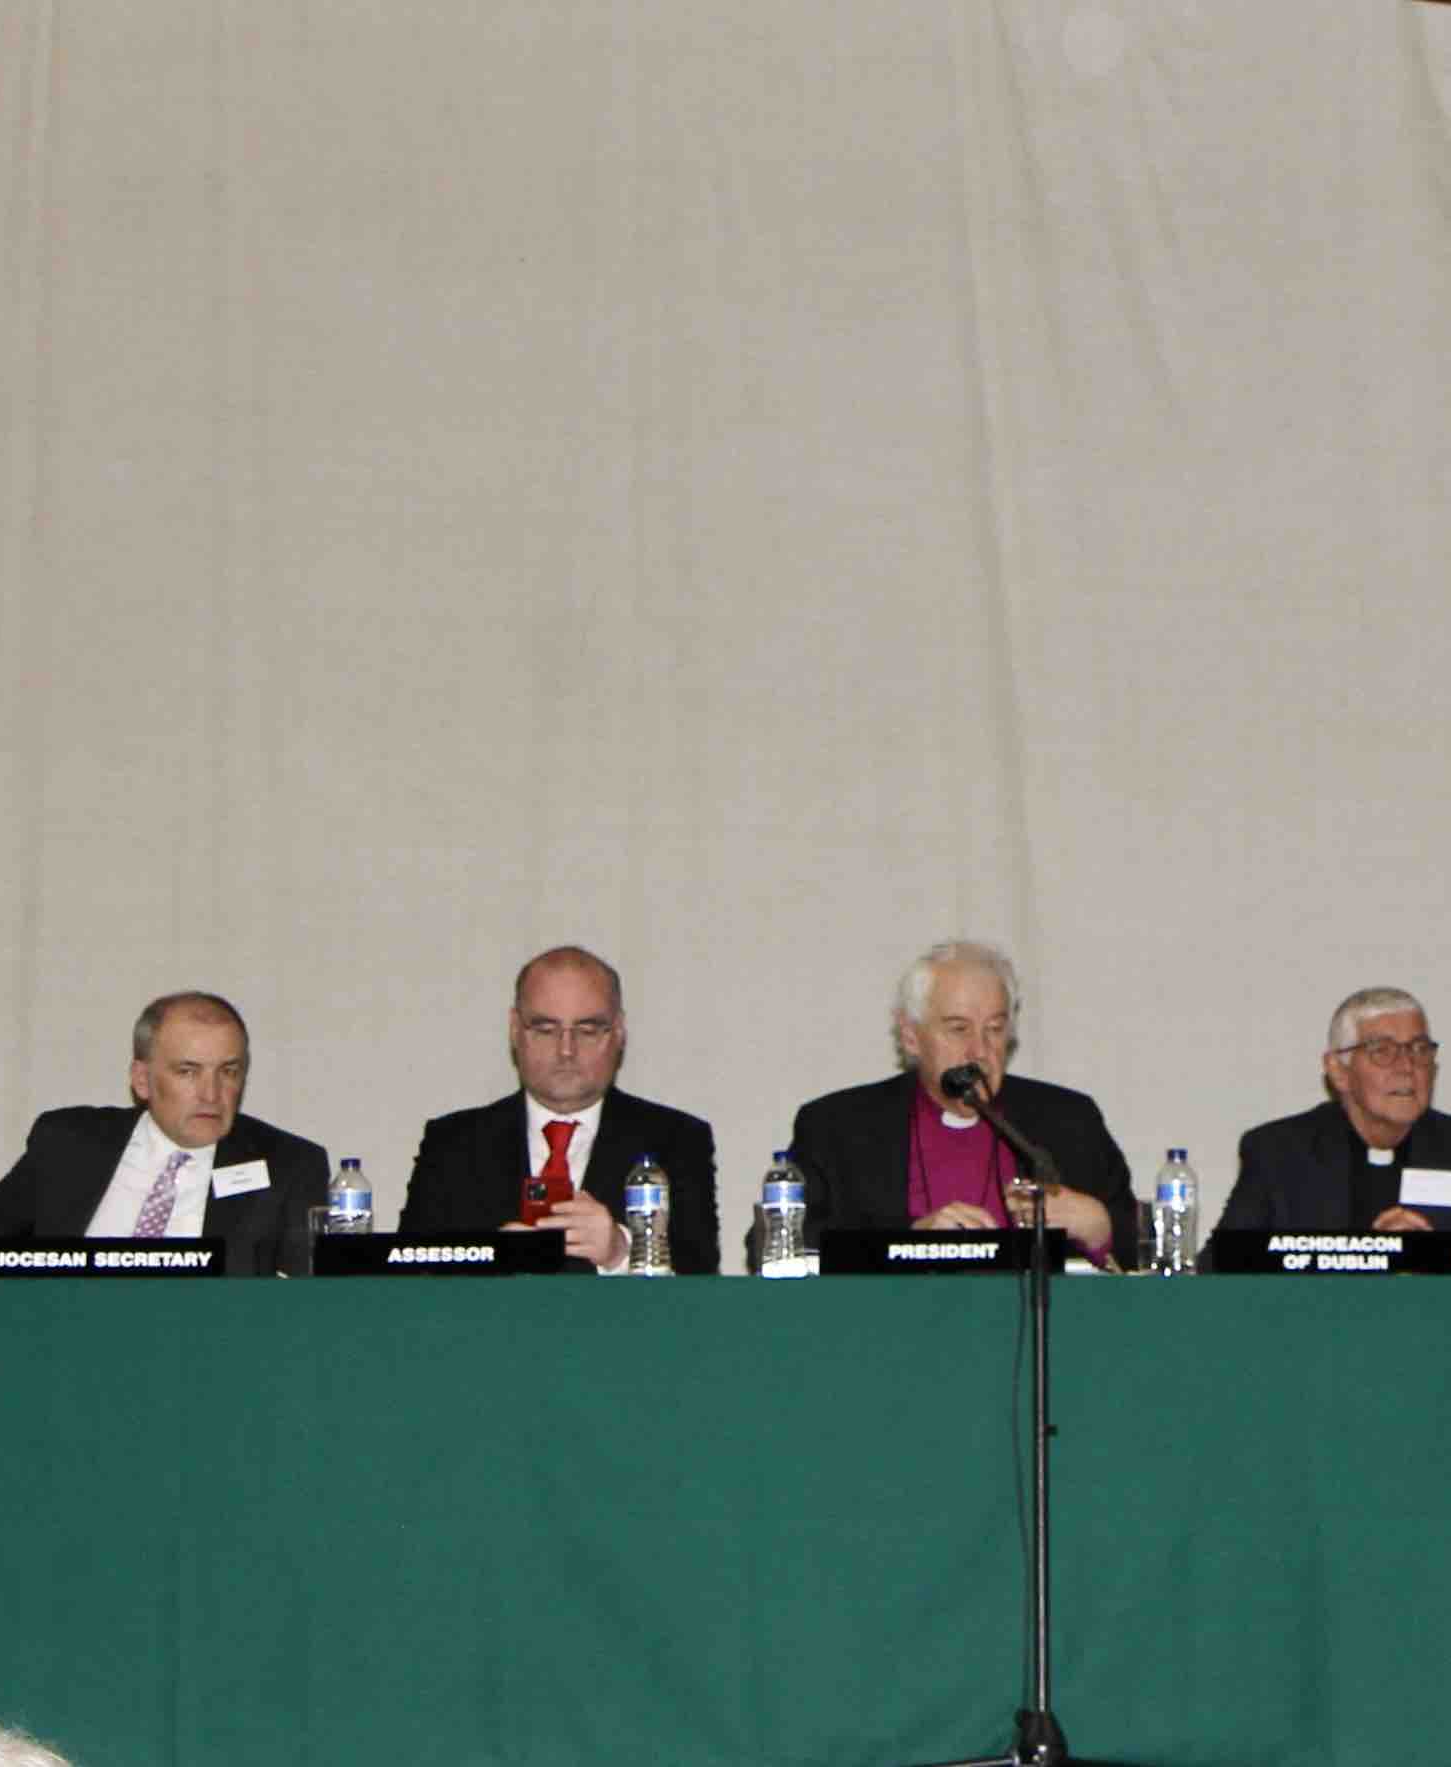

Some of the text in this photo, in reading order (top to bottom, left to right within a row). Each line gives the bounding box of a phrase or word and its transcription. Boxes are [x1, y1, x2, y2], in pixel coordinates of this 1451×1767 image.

[887, 1242, 1000, 1260] PRESIDENT
[1267, 1235, 1403, 1252] ARCHDEACON
[93, 1251, 213, 1268] SECRETARY
[387, 1245, 495, 1263] ASSESSOR
[1282, 1253, 1389, 1271] OF DUBLIN
